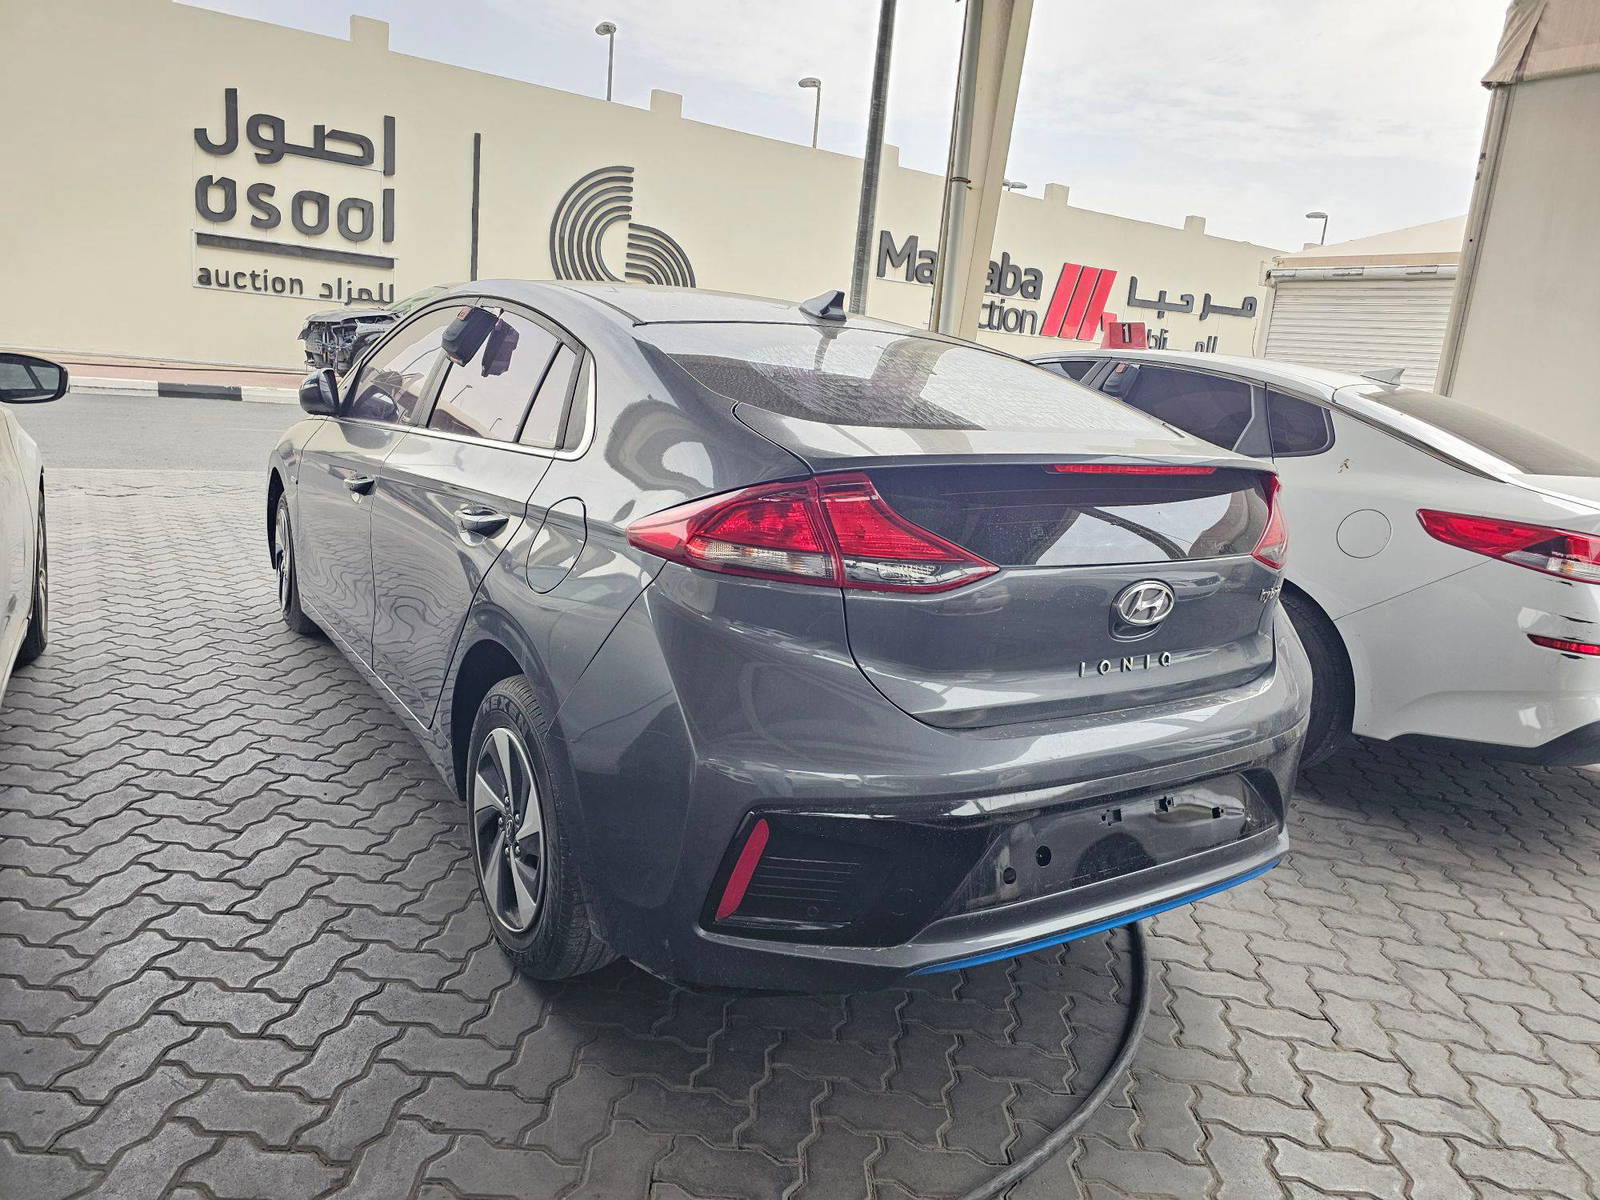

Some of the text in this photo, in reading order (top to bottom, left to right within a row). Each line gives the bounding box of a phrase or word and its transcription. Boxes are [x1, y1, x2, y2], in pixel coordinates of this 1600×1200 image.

[194, 87, 396, 176] اصول
[197, 266, 304, 296] auction
[876, 230, 1044, 301] Maaba
[319, 277, 394, 306] للمزاد
[1127, 275, 1258, 321] مرحبا
[978, 298, 1039, 336] tion
[1121, 322, 1132, 343] 1
[1078, 651, 1171, 678] IONIQ
